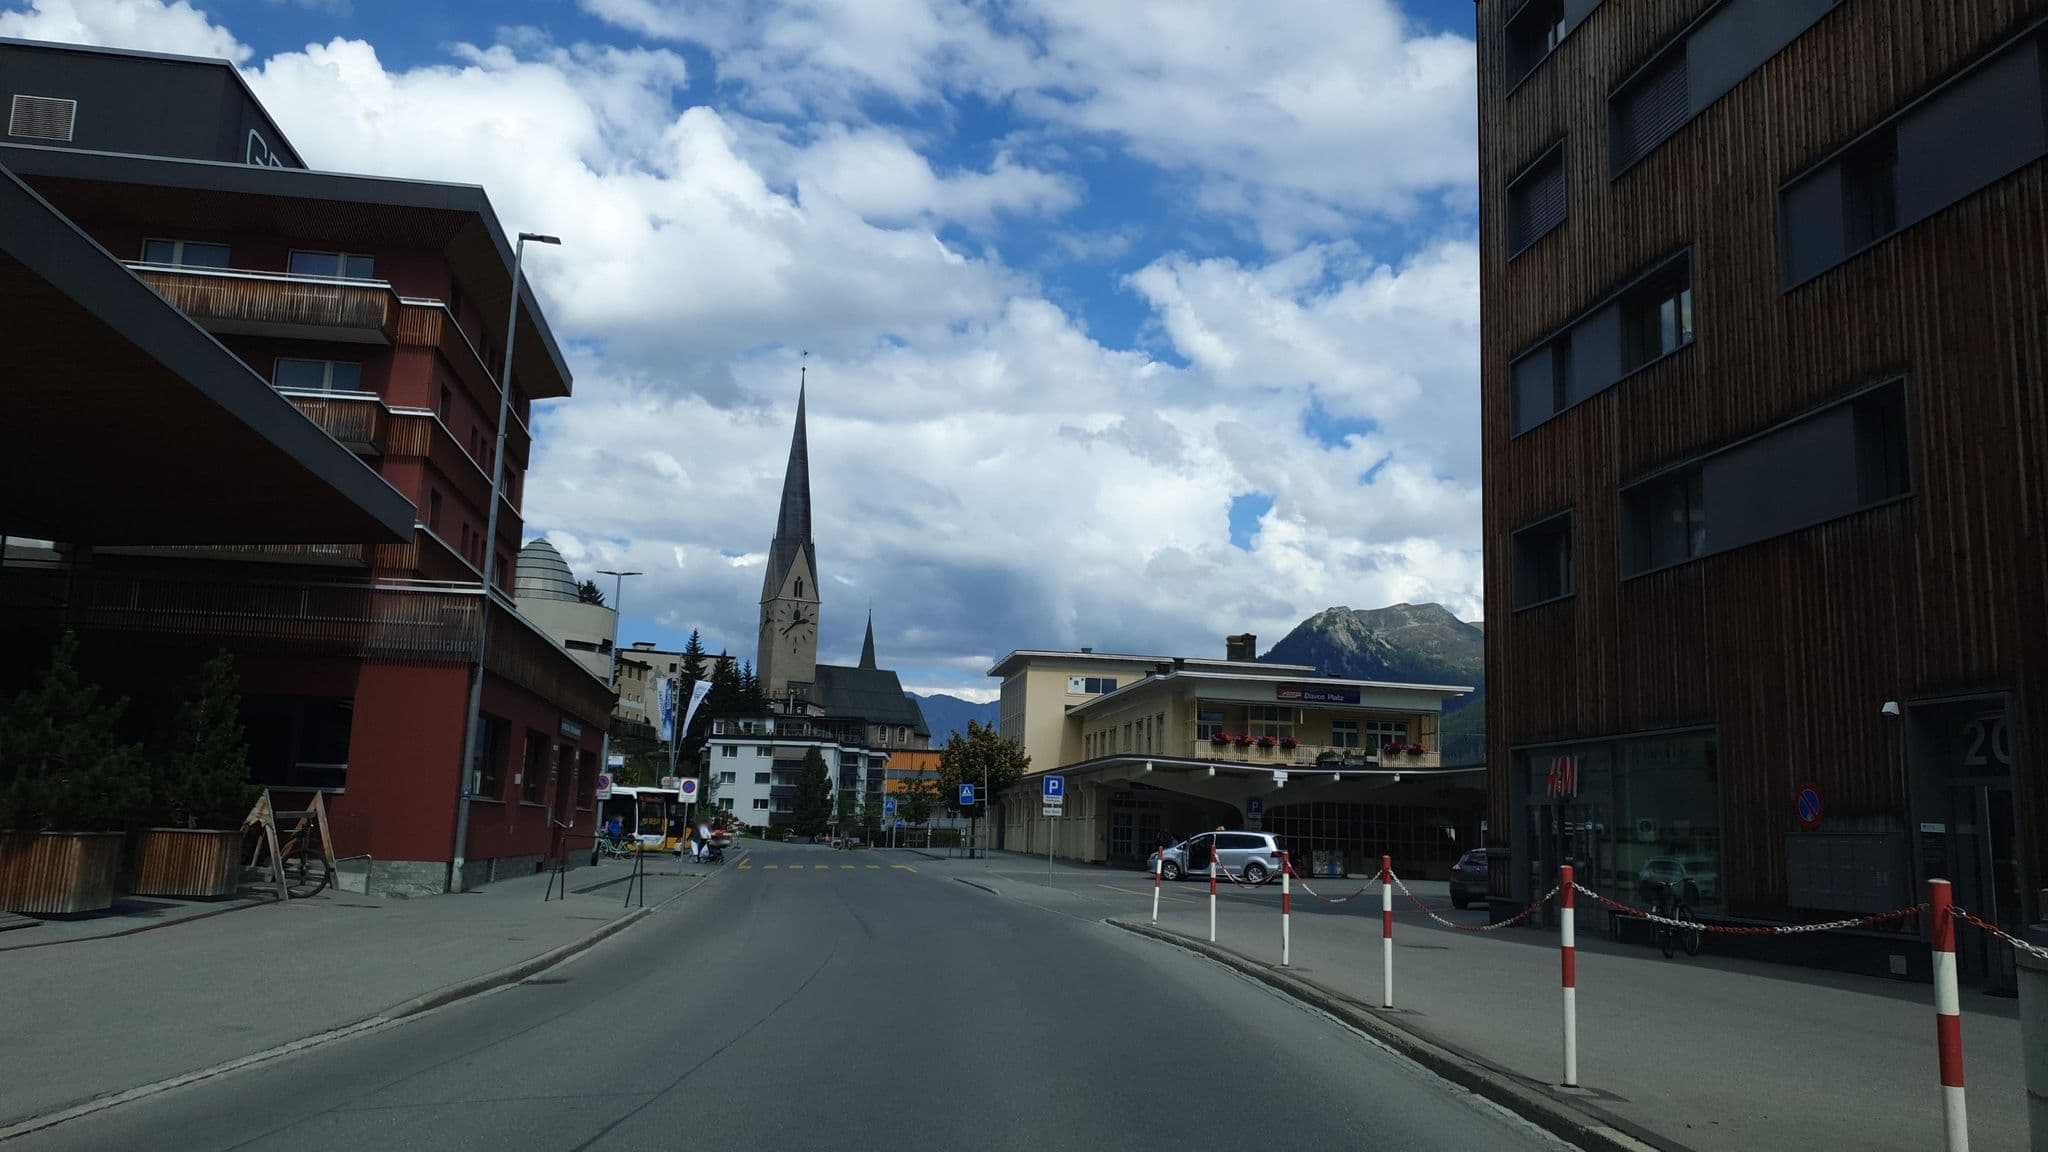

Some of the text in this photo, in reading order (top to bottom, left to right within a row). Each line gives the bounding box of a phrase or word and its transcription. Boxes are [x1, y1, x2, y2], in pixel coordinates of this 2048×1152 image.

[1304, 692, 1325, 700] Davos
[1327, 693, 1345, 701] Platz
[1049, 780, 1058, 794] P
